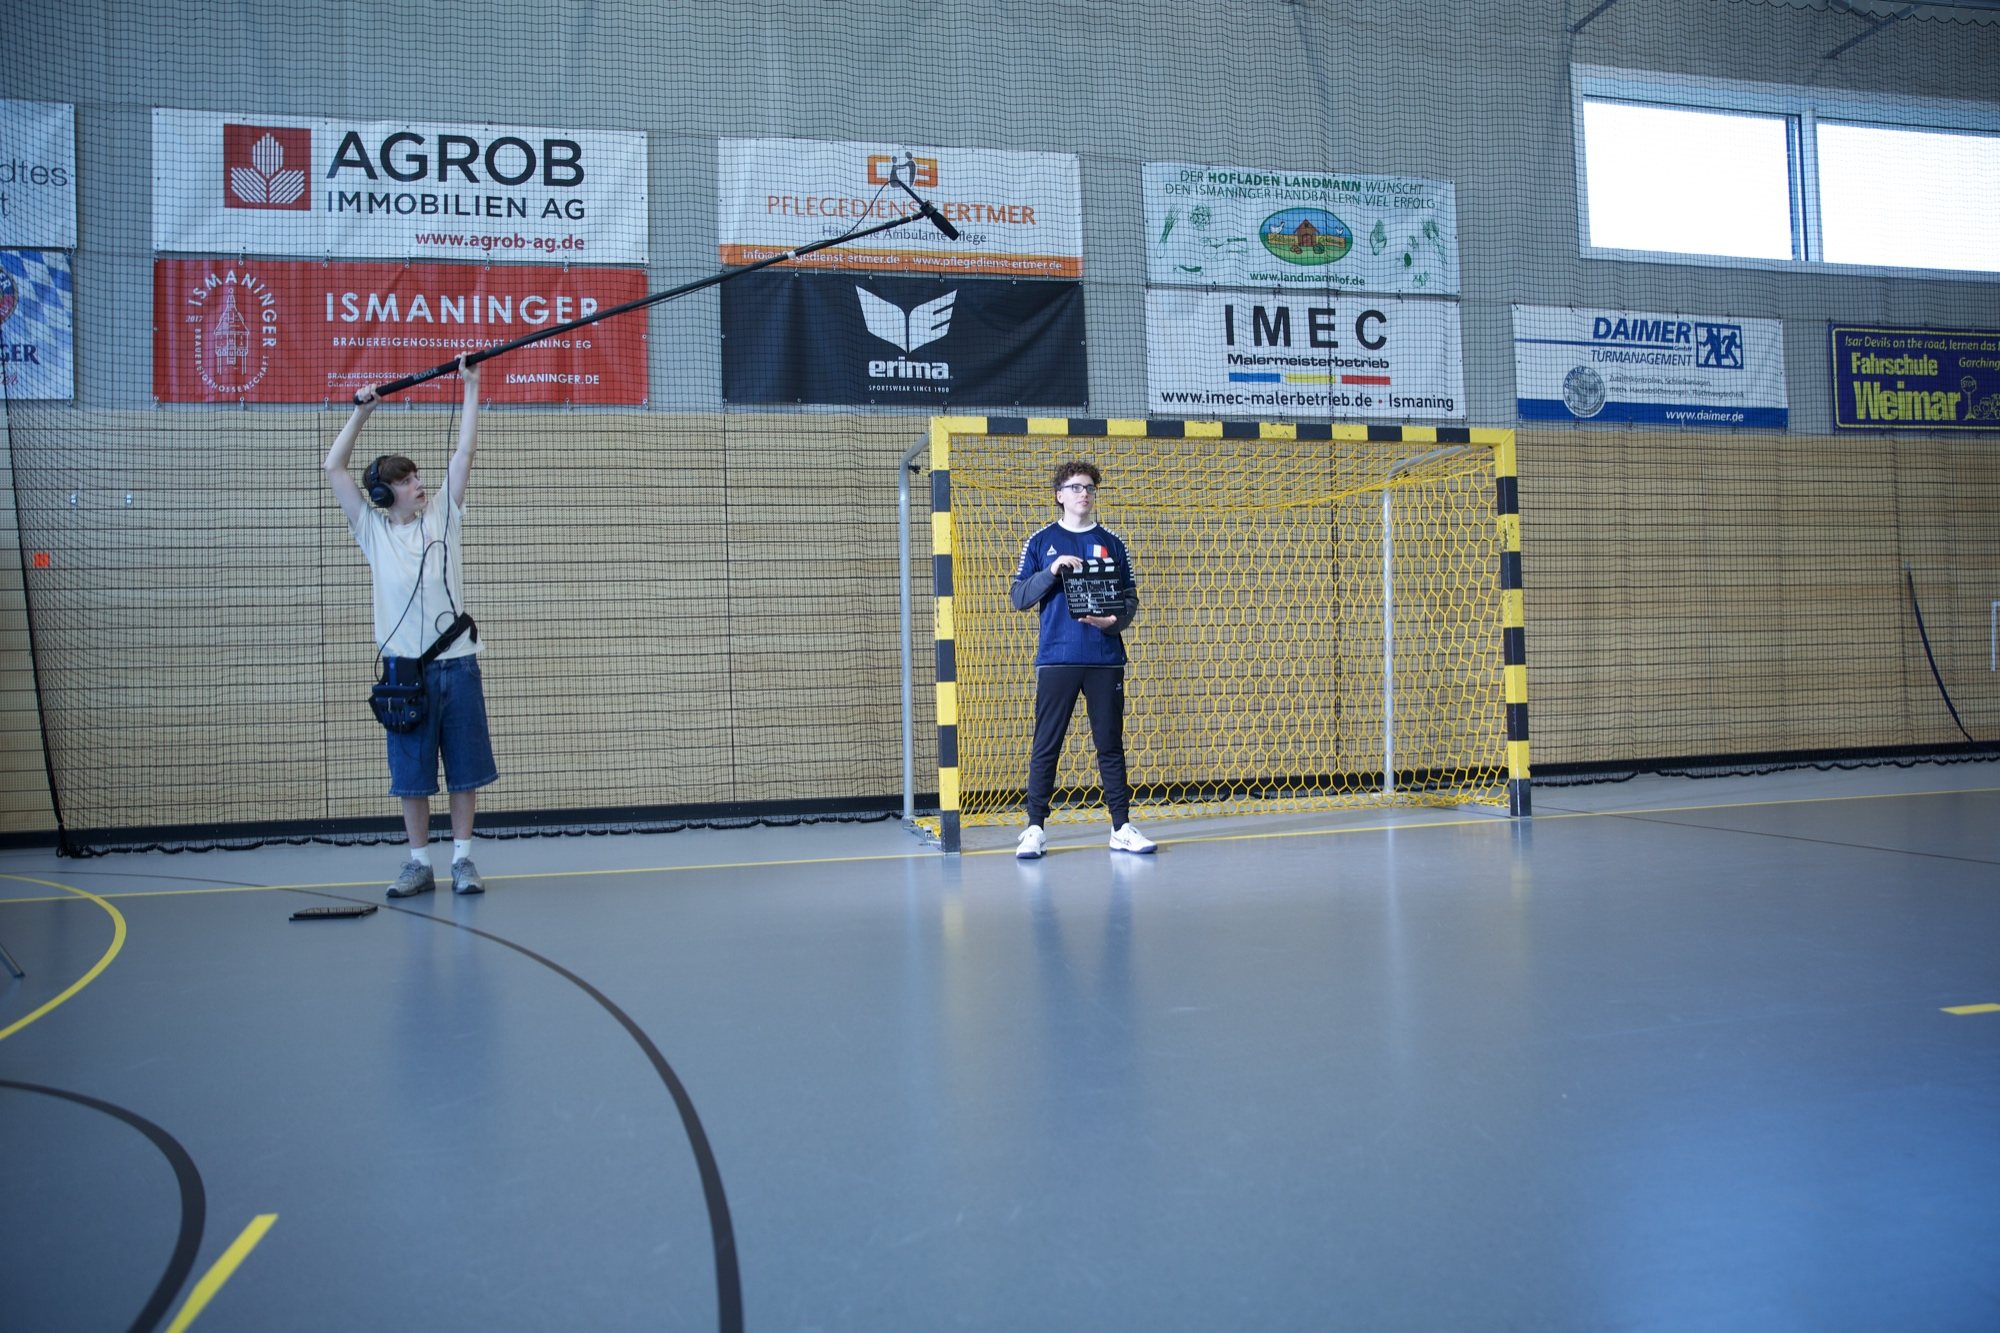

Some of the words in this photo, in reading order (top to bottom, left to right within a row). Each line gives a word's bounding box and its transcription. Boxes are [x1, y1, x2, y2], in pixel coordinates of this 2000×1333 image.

[327, 130, 585, 187] AGROB
[1180, 170, 1204, 182] DER
[1208, 172, 1280, 186] HOFLADEN
[1285, 176, 1361, 192] LANDMANN
[1365, 180, 1424, 195] WÜNSCHT
[327, 190, 528, 219] IMMOBILIEN
[541, 198, 586, 220] AG
[1166, 183, 1190, 195] DEN
[1195, 184, 1271, 199] ISMANINGER
[1276, 188, 1360, 205] HANDBALLERN
[1364, 195, 1389, 207] VIEL
[1393, 196, 1436, 209] ERFOLG
[767, 195, 934, 219] PFLEGEDIENS
[943, 202, 1037, 225] ERTMER
[415, 232, 585, 253] www.agrob-ag.de
[884, 228, 947, 241] Ambulante
[953, 230, 987, 245] flege
[912, 254, 1062, 271] www.pflegedienst-ertmer.de
[1250, 271, 1366, 286] www.landmannhof.de
[188, 269, 277, 347] ISMANINGER
[326, 292, 599, 325] ISMANINGER
[1225, 304, 1388, 350] IMEC
[1592, 317, 1692, 344] DAIMER
[333, 337, 505, 349] BRAUEREIGENOSSENSCHAFT
[576, 340, 592, 349] EG
[1864, 336, 1891, 348] Devils
[1893, 339, 1905, 348] on
[1907, 337, 1922, 349] the
[1949, 339, 1979, 350] lernen
[1980, 340, 1996, 352] das
[869, 356, 949, 379] erima
[1227, 353, 1390, 369] Malermeisterbetrieb
[1590, 347, 1693, 366] TÜRMANAGEMENT
[1851, 352, 1938, 376] Fahrschule
[506, 372, 600, 385] ISMANINGER.DE
[868, 385, 911, 393] SPORTSWEAR
[934, 386, 950, 394] 1900
[1161, 389, 1373, 408] www.imec-malerbetrieb.de
[1388, 393, 1454, 412] Ismaning
[1852, 380, 1961, 421] Weimar
[1666, 409, 1744, 423] www.daimer.de
